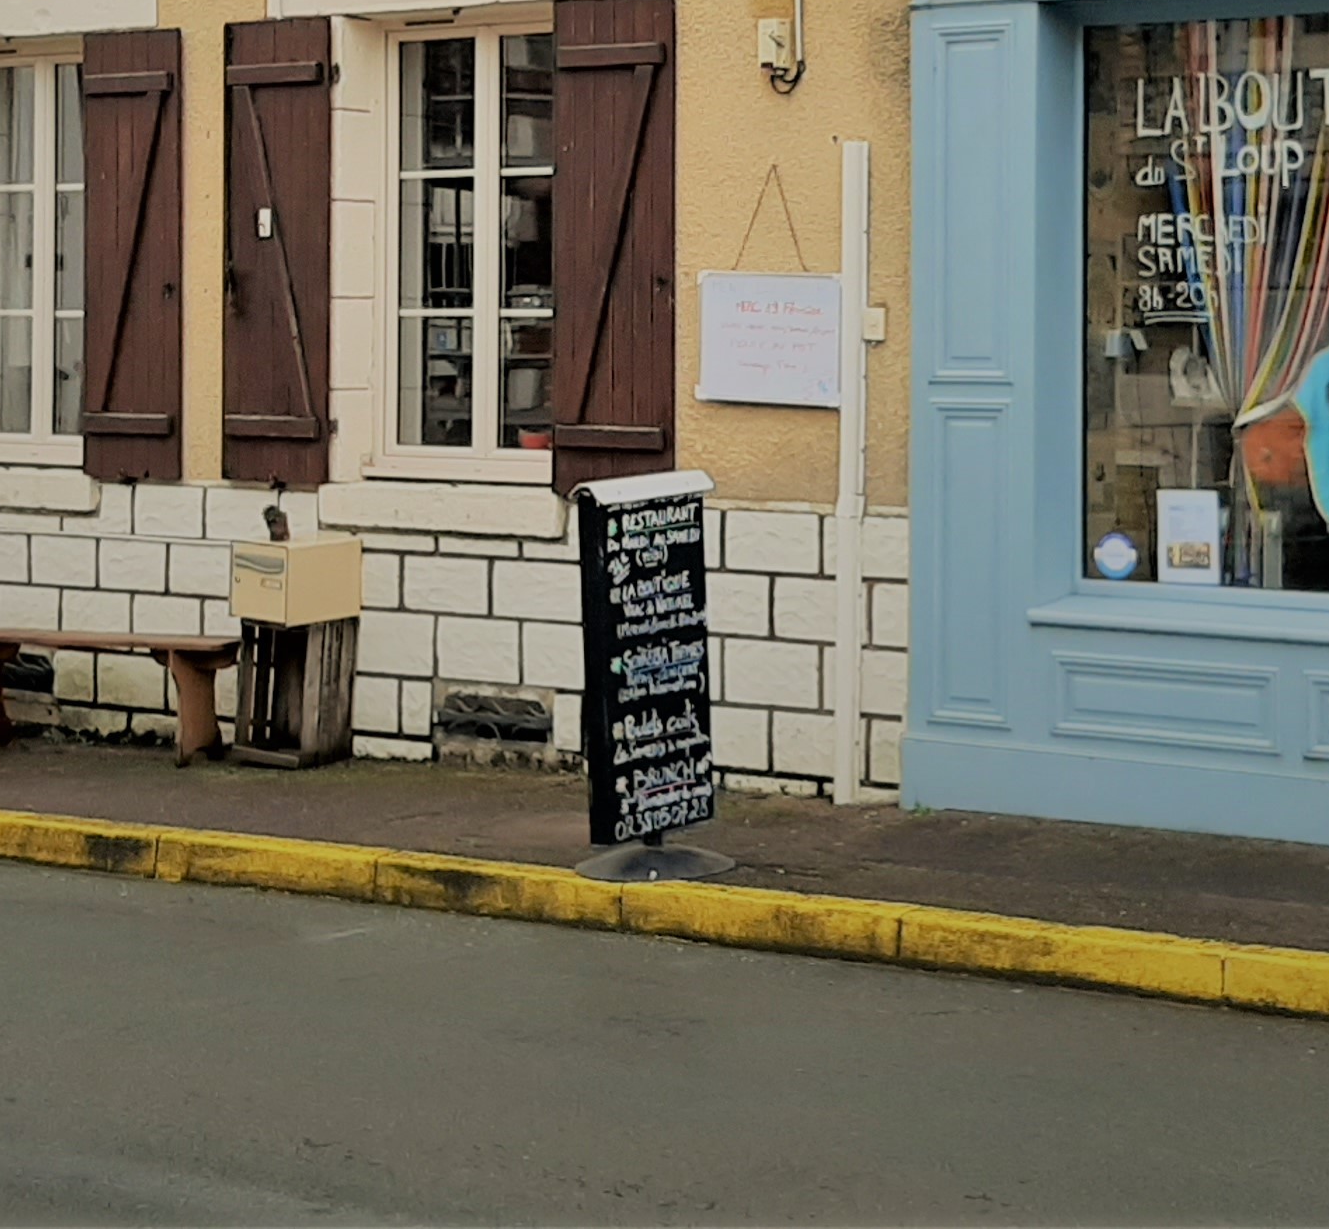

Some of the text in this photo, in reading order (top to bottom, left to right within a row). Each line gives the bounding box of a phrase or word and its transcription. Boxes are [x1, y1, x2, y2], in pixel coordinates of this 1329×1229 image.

[1136, 76, 1190, 138] LA
[621, 503, 699, 532] RESTAURANT
[633, 757, 696, 791] BRUNCH
